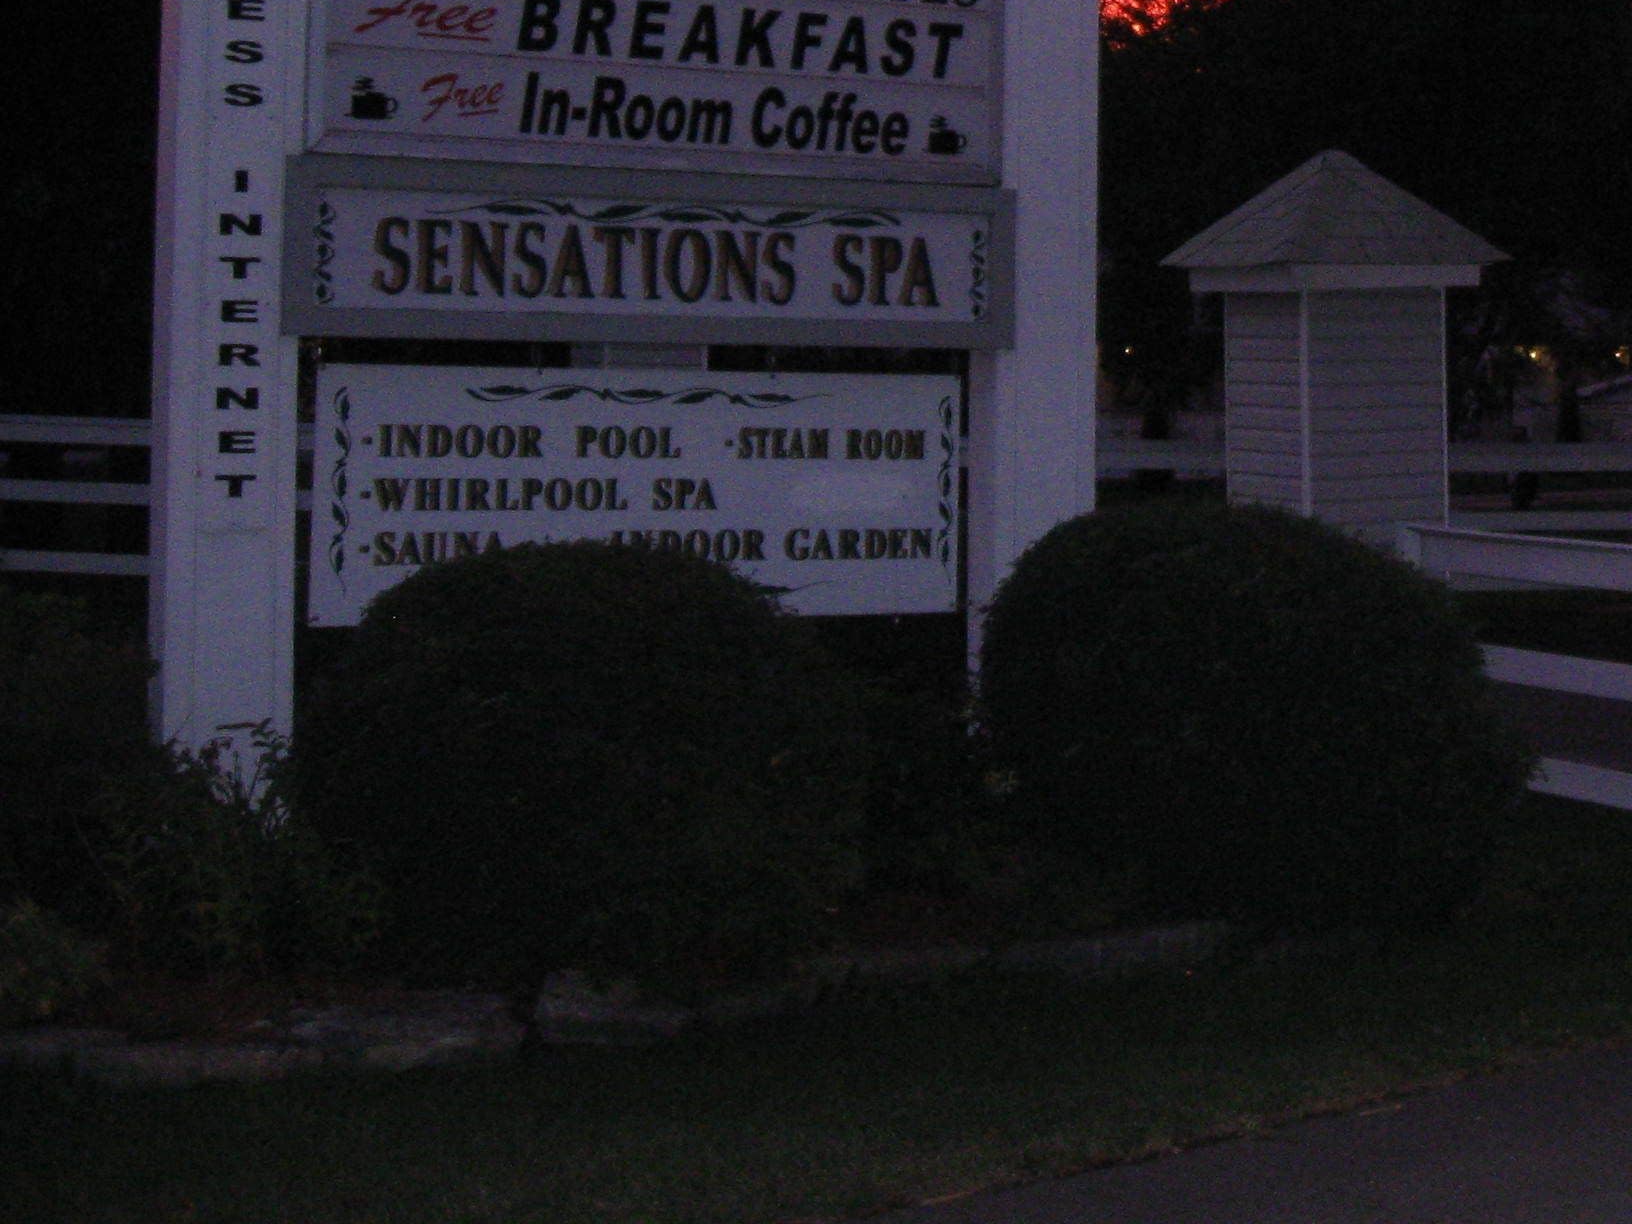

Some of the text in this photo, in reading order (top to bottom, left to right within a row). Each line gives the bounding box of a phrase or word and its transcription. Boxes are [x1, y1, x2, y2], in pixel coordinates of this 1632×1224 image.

[421, 71, 910, 156] Free In-Room Coffee
[373, 217, 940, 307] SENSATIONS SPA
[214, 170, 263, 498] INTERNET
[377, 424, 681, 459] INDOOR POOL
[738, 427, 927, 460] STEAM ROOM
[374, 477, 717, 511] WHIRLPOOL SPA
[784, 528, 932, 561] GARDEN
